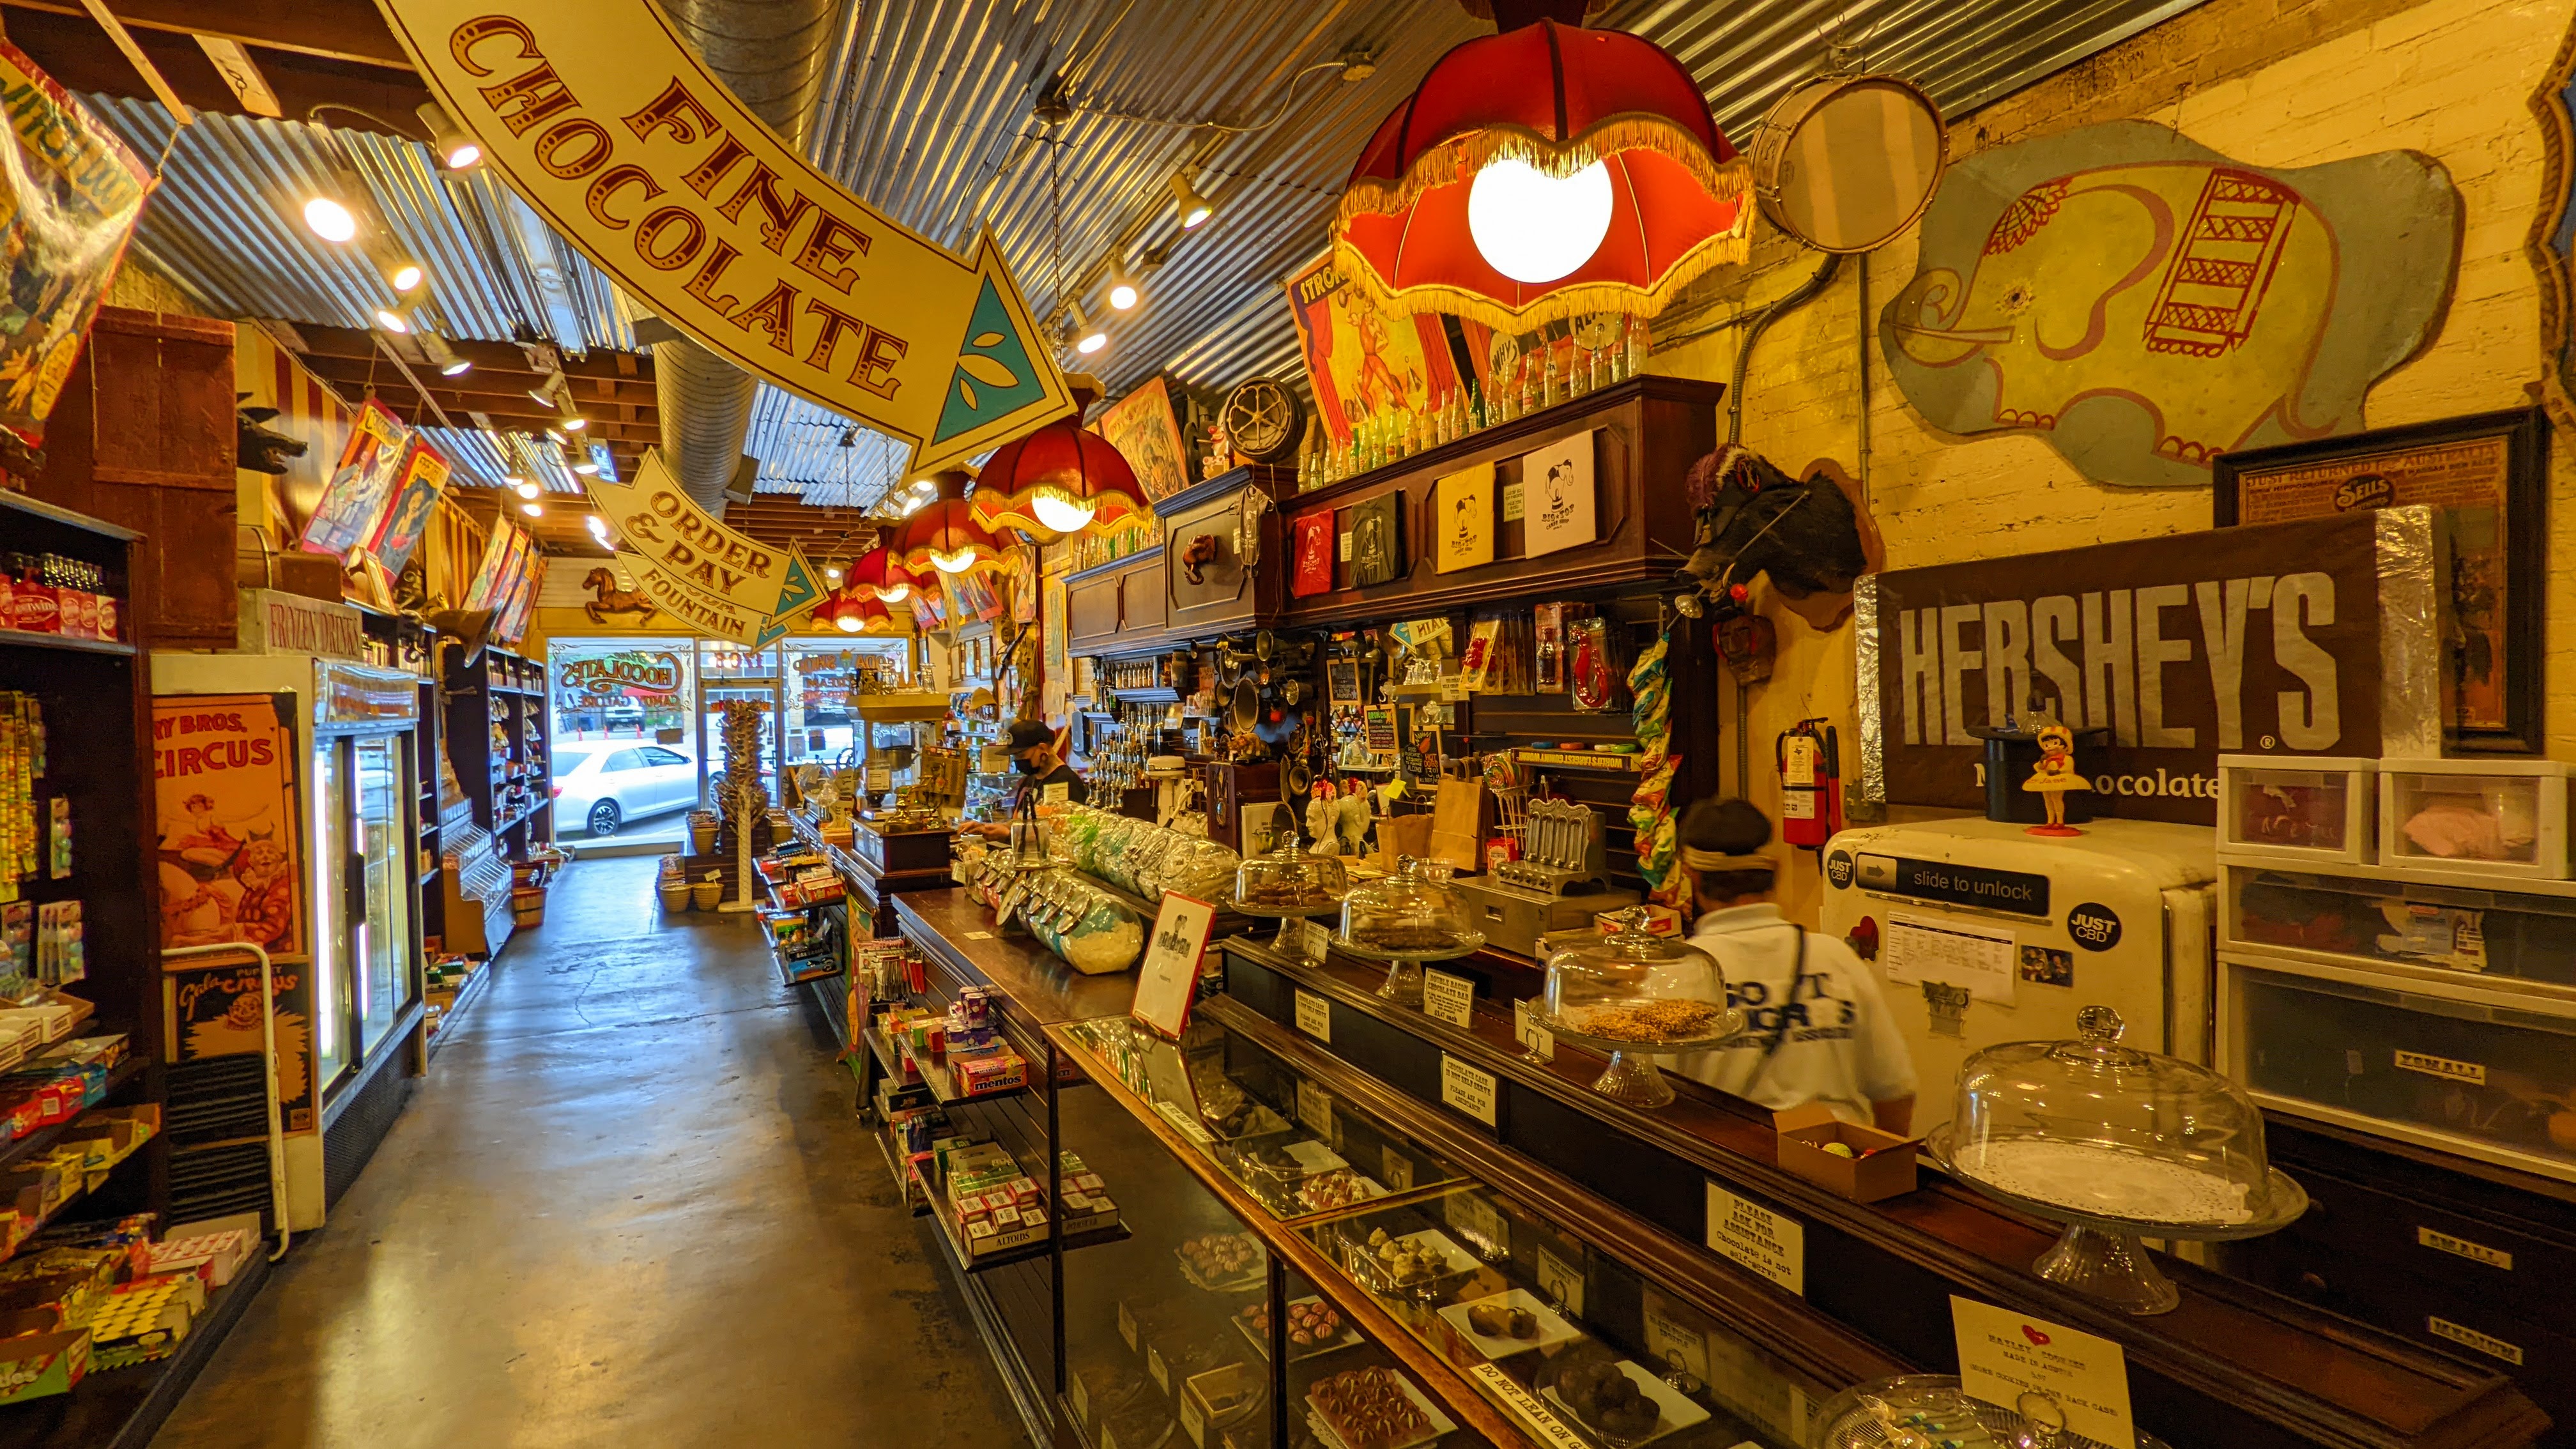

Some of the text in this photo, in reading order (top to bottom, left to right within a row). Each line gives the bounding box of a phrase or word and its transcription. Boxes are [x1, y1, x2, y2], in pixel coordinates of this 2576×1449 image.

[621, 76, 872, 296] FINE
[449, 15, 908, 402] CHOCOLATE
[2289, 462, 2370, 482] RETURNED
[2337, 478, 2390, 507] SELLS
[650, 491, 772, 579] ORDER
[625, 512, 747, 596] & PAY
[641, 567, 746, 638] FOUNTAIN
[270, 603, 316, 651] FROZEN
[1900, 571, 2342, 751] HERSHEY'S
[180, 712, 247, 734] BROS.
[1540, 753, 1564, 763] GUMMY
[1565, 754, 1592, 766] LARGEST
[1593, 756, 1623, 768] WORLD'S
[2092, 769, 2219, 799] ocolate
[1828, 859, 1851, 872] JUST
[1831, 870, 1848, 881] CBD
[1914, 870, 2032, 901] slide to unlock
[2071, 914, 2117, 933] JUST
[2075, 926, 2108, 942] CBD
[222, 974, 300, 994] CIRUS
[974, 1075, 1022, 1091] mentos
[1732, 1211, 1775, 1239] ASK FOR
[1733, 1198, 1773, 1226] PLEASE
[996, 1231, 1030, 1247] ALTOIDS
[1723, 1218, 1784, 1257] ASSISTANCE
[1716, 1230, 1791, 1275] Chocolate is not
[1729, 1250, 1777, 1279] self-serve
[2003, 1351, 2026, 1363] MADE
[2029, 1358, 2039, 1367] IN
[1478, 1365, 1498, 1378] DO
[1495, 1376, 1521, 1397] NOT
[1517, 1395, 1553, 1425] LEAN
[1551, 1425, 1571, 1440] ON
